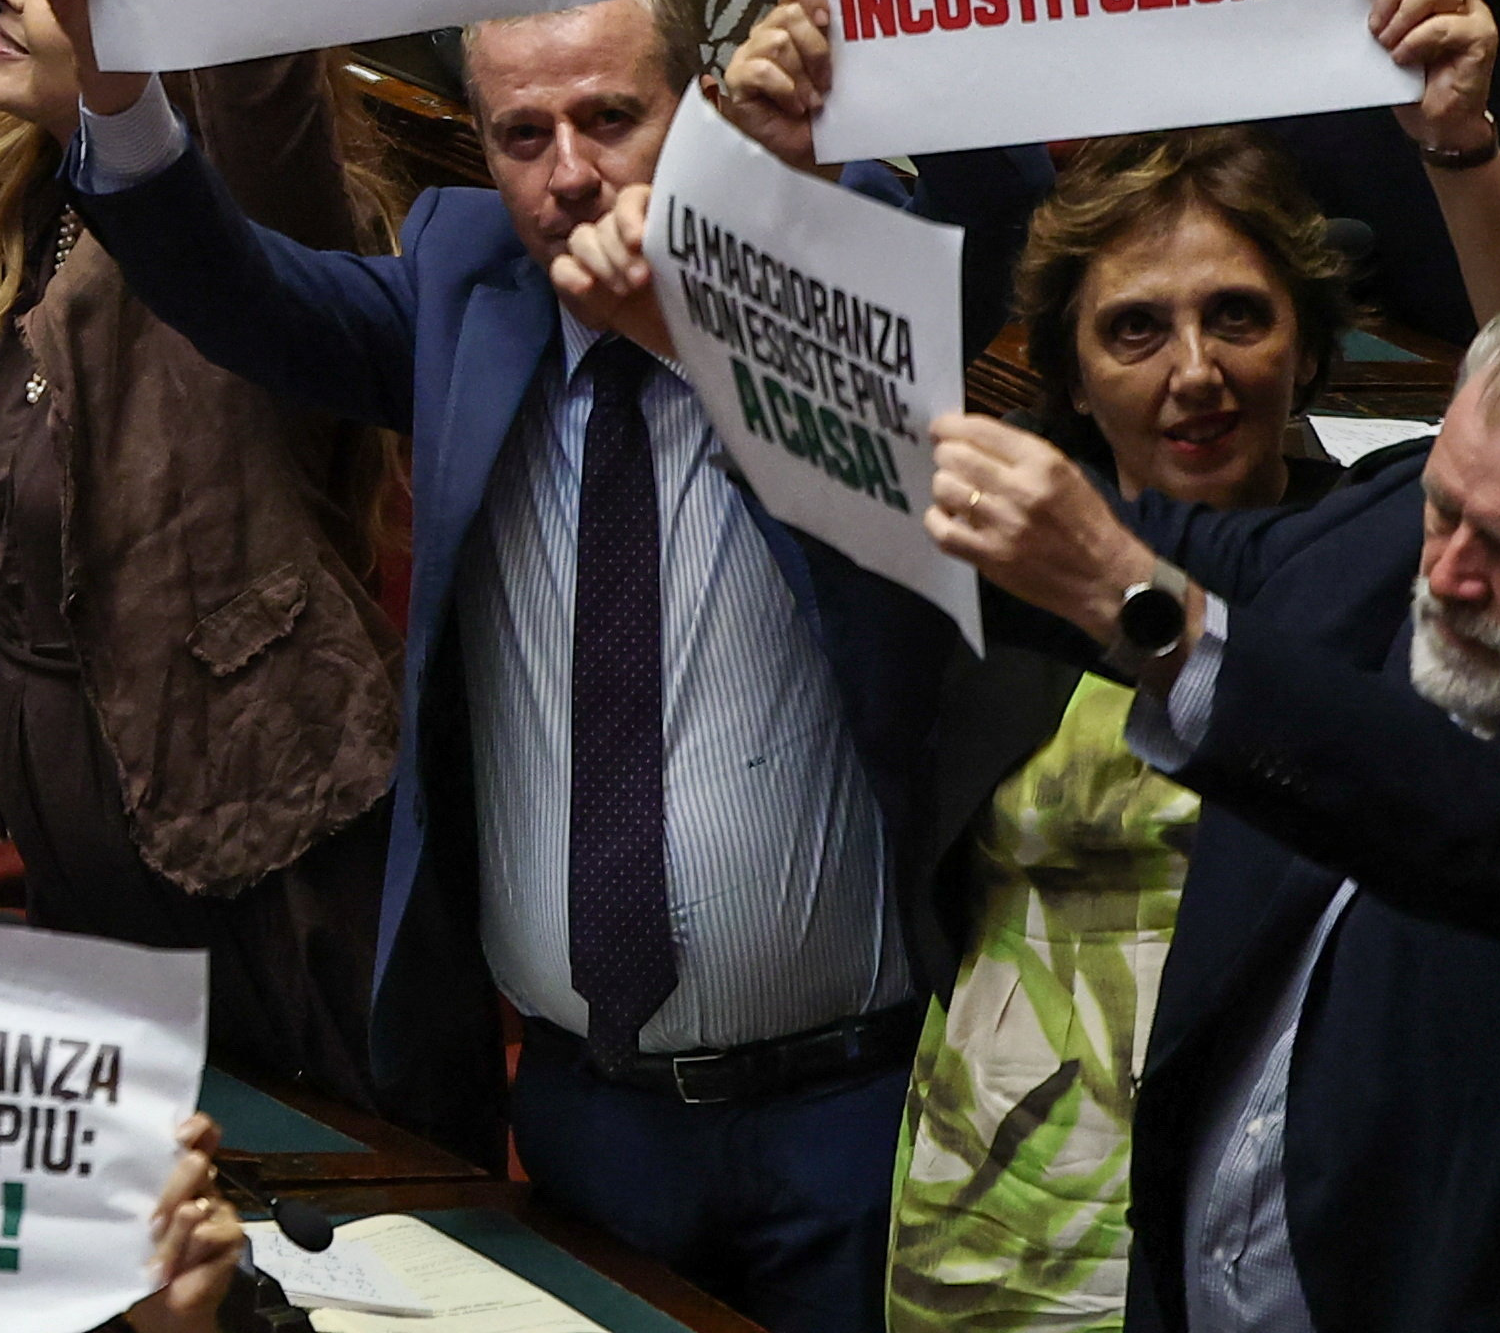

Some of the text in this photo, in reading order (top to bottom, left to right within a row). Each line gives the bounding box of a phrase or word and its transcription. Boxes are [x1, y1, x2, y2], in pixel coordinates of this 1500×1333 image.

[666, 195, 915, 384] LA MAGGIORANZA
[679, 268, 748, 355] NON
[742, 303, 854, 412] ESISTE
[730, 355, 911, 514] A CASA!
